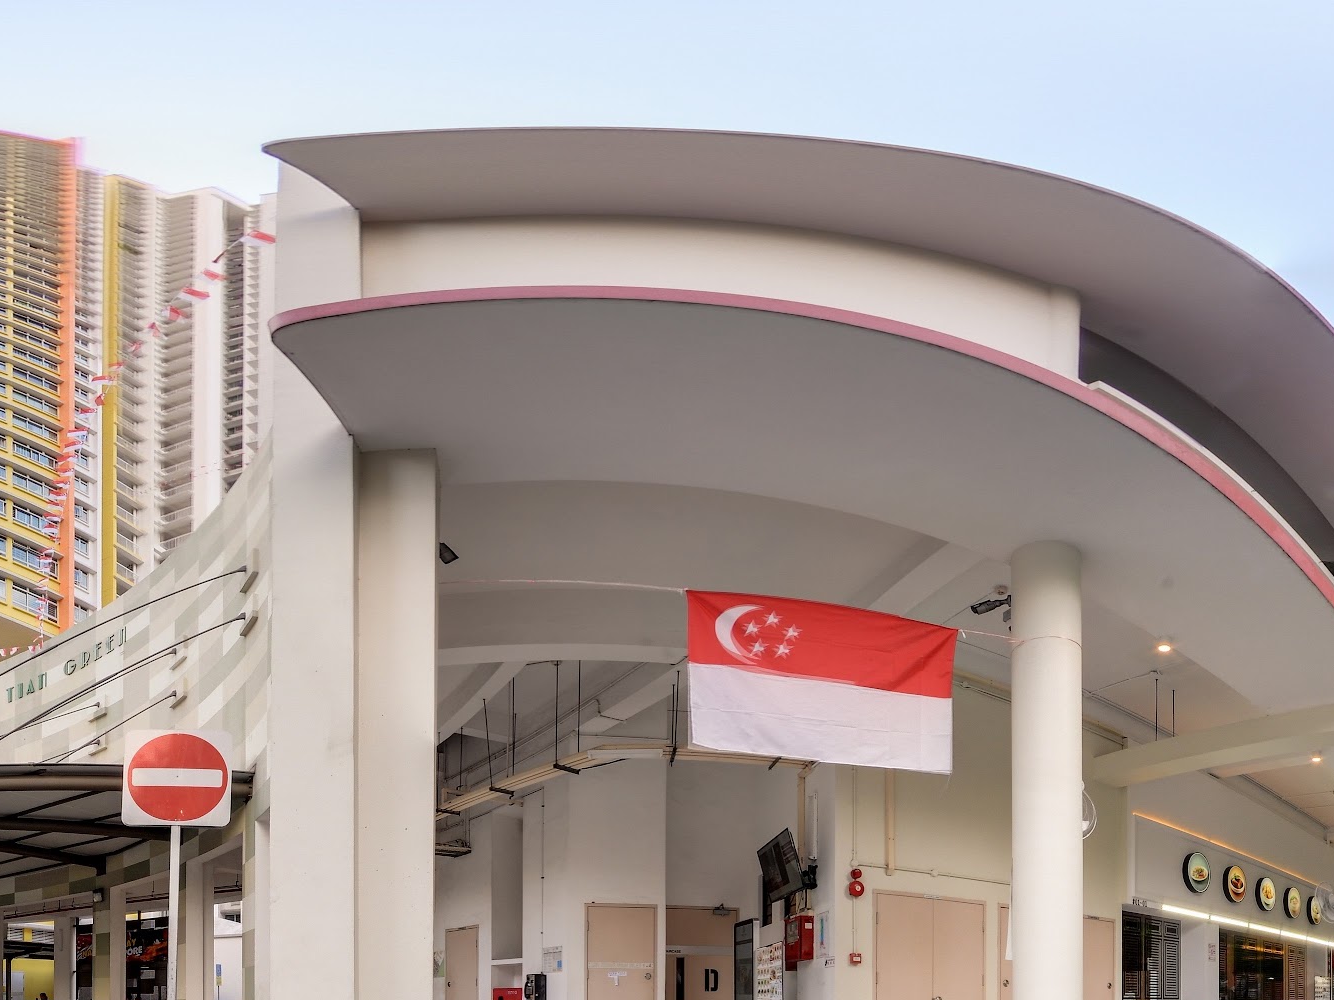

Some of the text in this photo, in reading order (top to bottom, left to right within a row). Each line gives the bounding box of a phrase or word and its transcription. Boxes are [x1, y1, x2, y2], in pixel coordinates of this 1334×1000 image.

[5, 672, 48, 703] TIAN
[63, 626, 128, 676] GREEN
[704, 968, 719, 992] D
